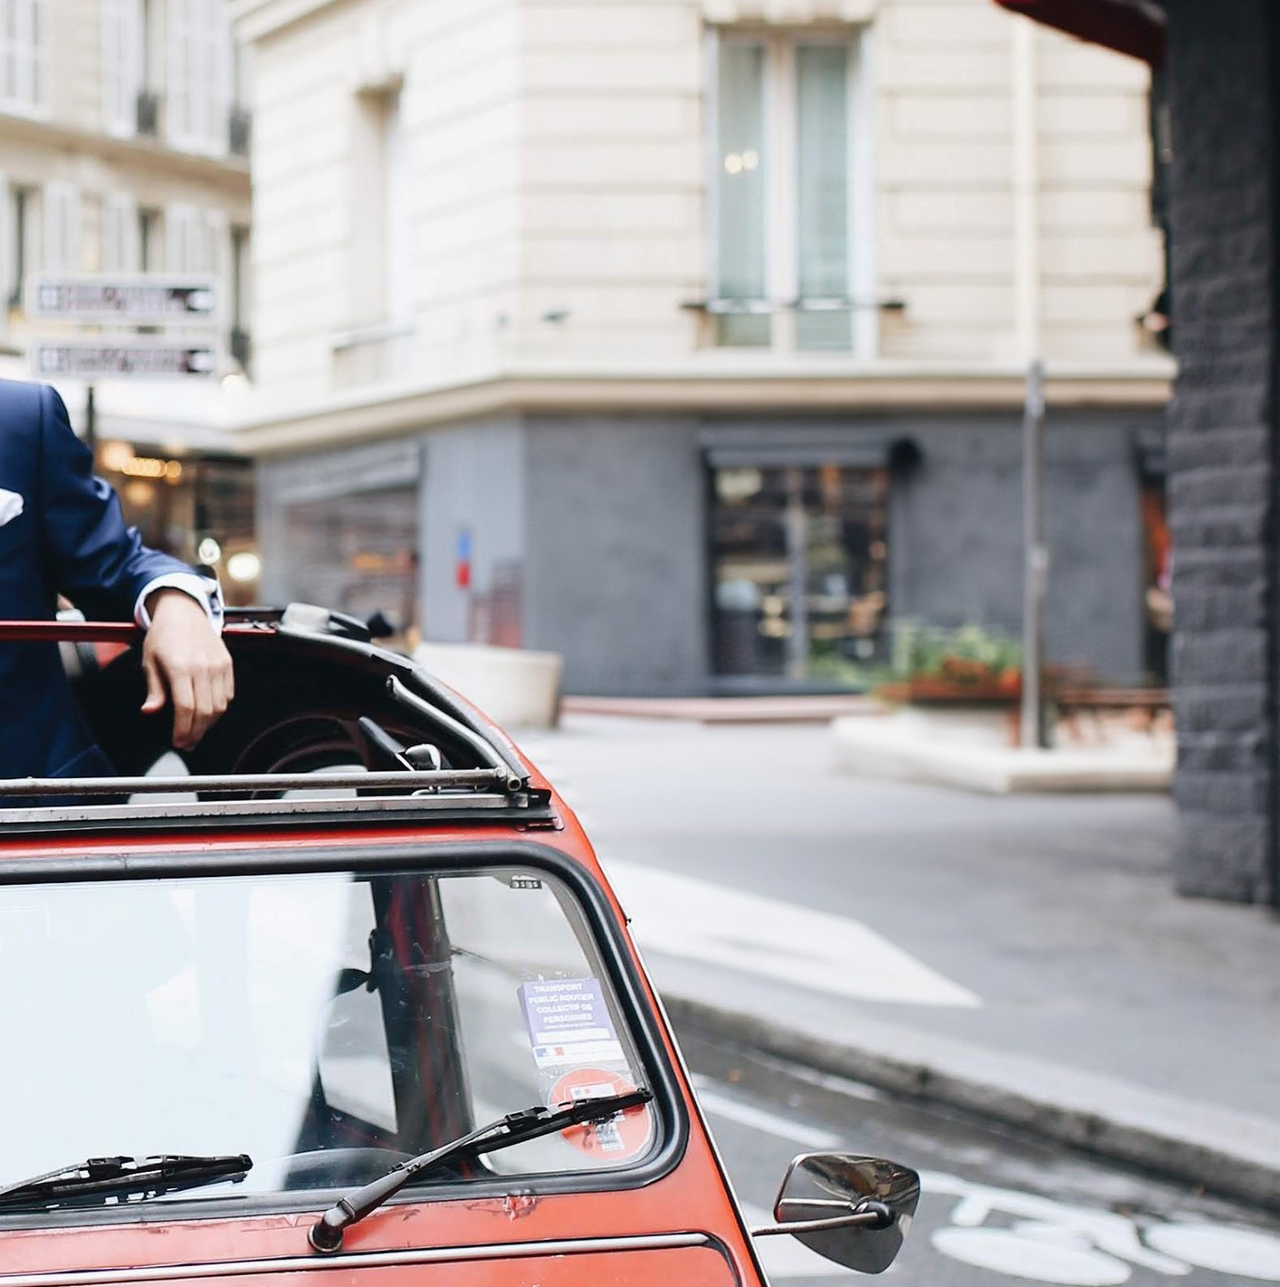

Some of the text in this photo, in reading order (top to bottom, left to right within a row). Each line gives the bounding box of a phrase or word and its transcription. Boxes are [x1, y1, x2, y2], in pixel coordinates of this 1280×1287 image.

[534, 983, 583, 993] TRANSPORT
[528, 993, 594, 1004] PUBLIC ROUTIER
[537, 1004, 581, 1013] COLLECTIF
[543, 1013, 593, 1023] PERSONNES
